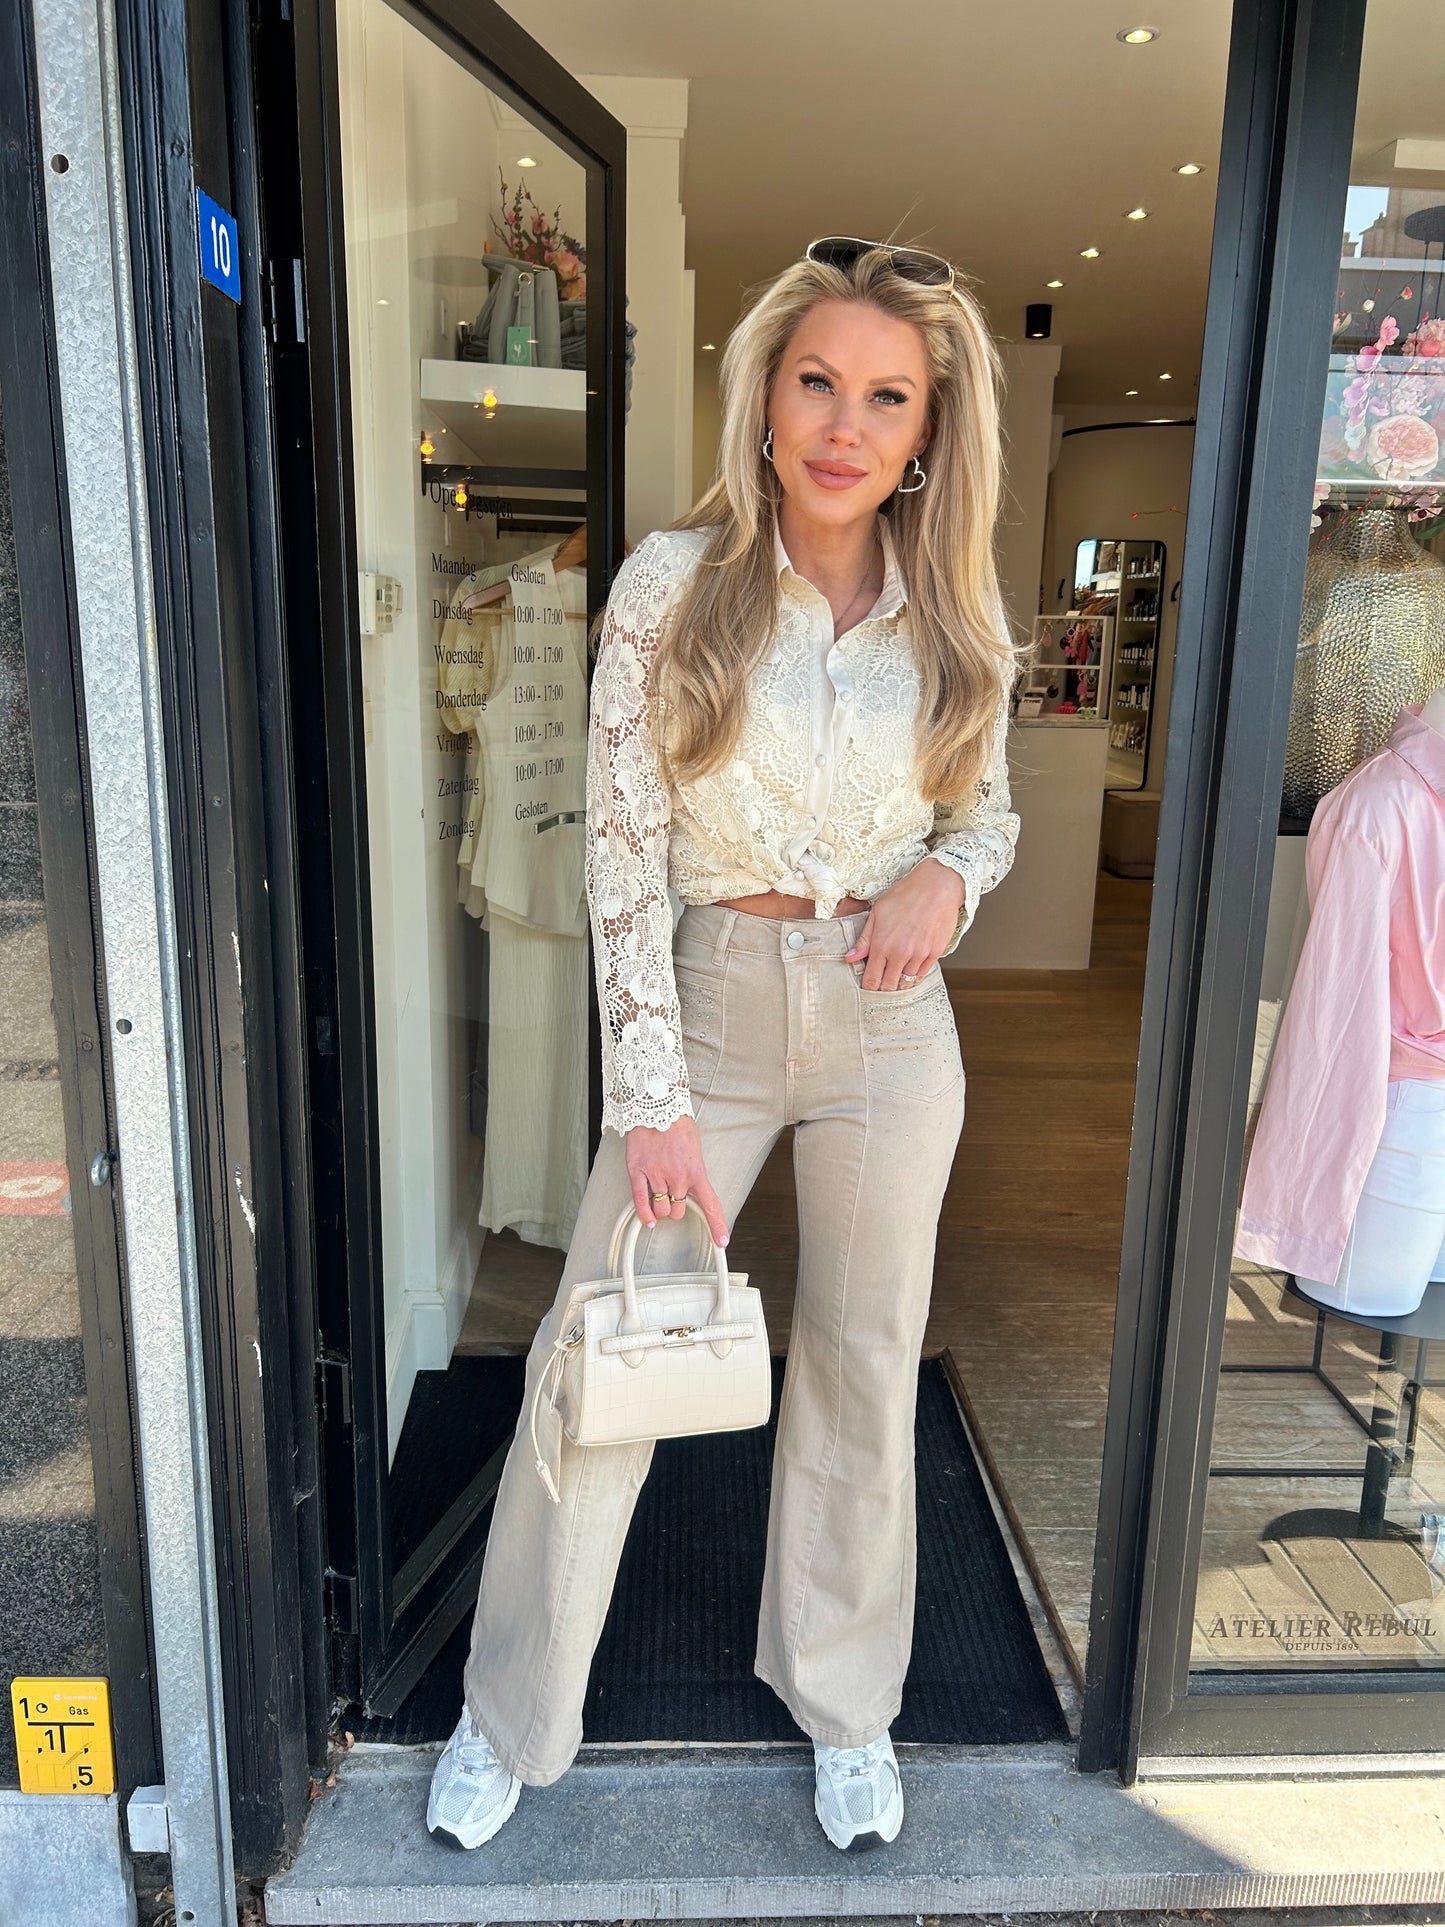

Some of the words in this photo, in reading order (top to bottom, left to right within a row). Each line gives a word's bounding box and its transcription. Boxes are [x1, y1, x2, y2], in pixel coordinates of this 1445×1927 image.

[211, 215, 231, 278] 10
[429, 478, 513, 520] Opengsuren
[432, 552, 477, 582] Maandag
[511, 564, 546, 585] Gesloten
[433, 600, 473, 625] Dinsdag
[513, 605, 535, 623] 10:00
[543, 608, 563, 625] 17:00
[434, 645, 484, 668] Woensdag
[514, 646, 535, 664] 10:00
[543, 647, 563, 664] 17:00
[435, 688, 488, 711] Donderdag
[514, 686, 535, 704] 13:00
[544, 684, 564, 702] 17:00
[436, 734, 473, 757] Vrijdag
[514, 724, 536, 744] 10:00
[544, 721, 564, 740] 17:00
[438, 774, 479, 797] Zaterdag
[515, 762, 537, 783] 10:00
[545, 757, 565, 777] 17:00
[439, 818, 475, 841] Zondag
[515, 801, 548, 822] Gesloten
[1210, 1617, 1331, 1639] ATELIER
[1285, 1642, 1333, 1651] DEPUIS
[19, 1697, 29, 1719] 1
[68, 1706, 89, 1716] Gas
